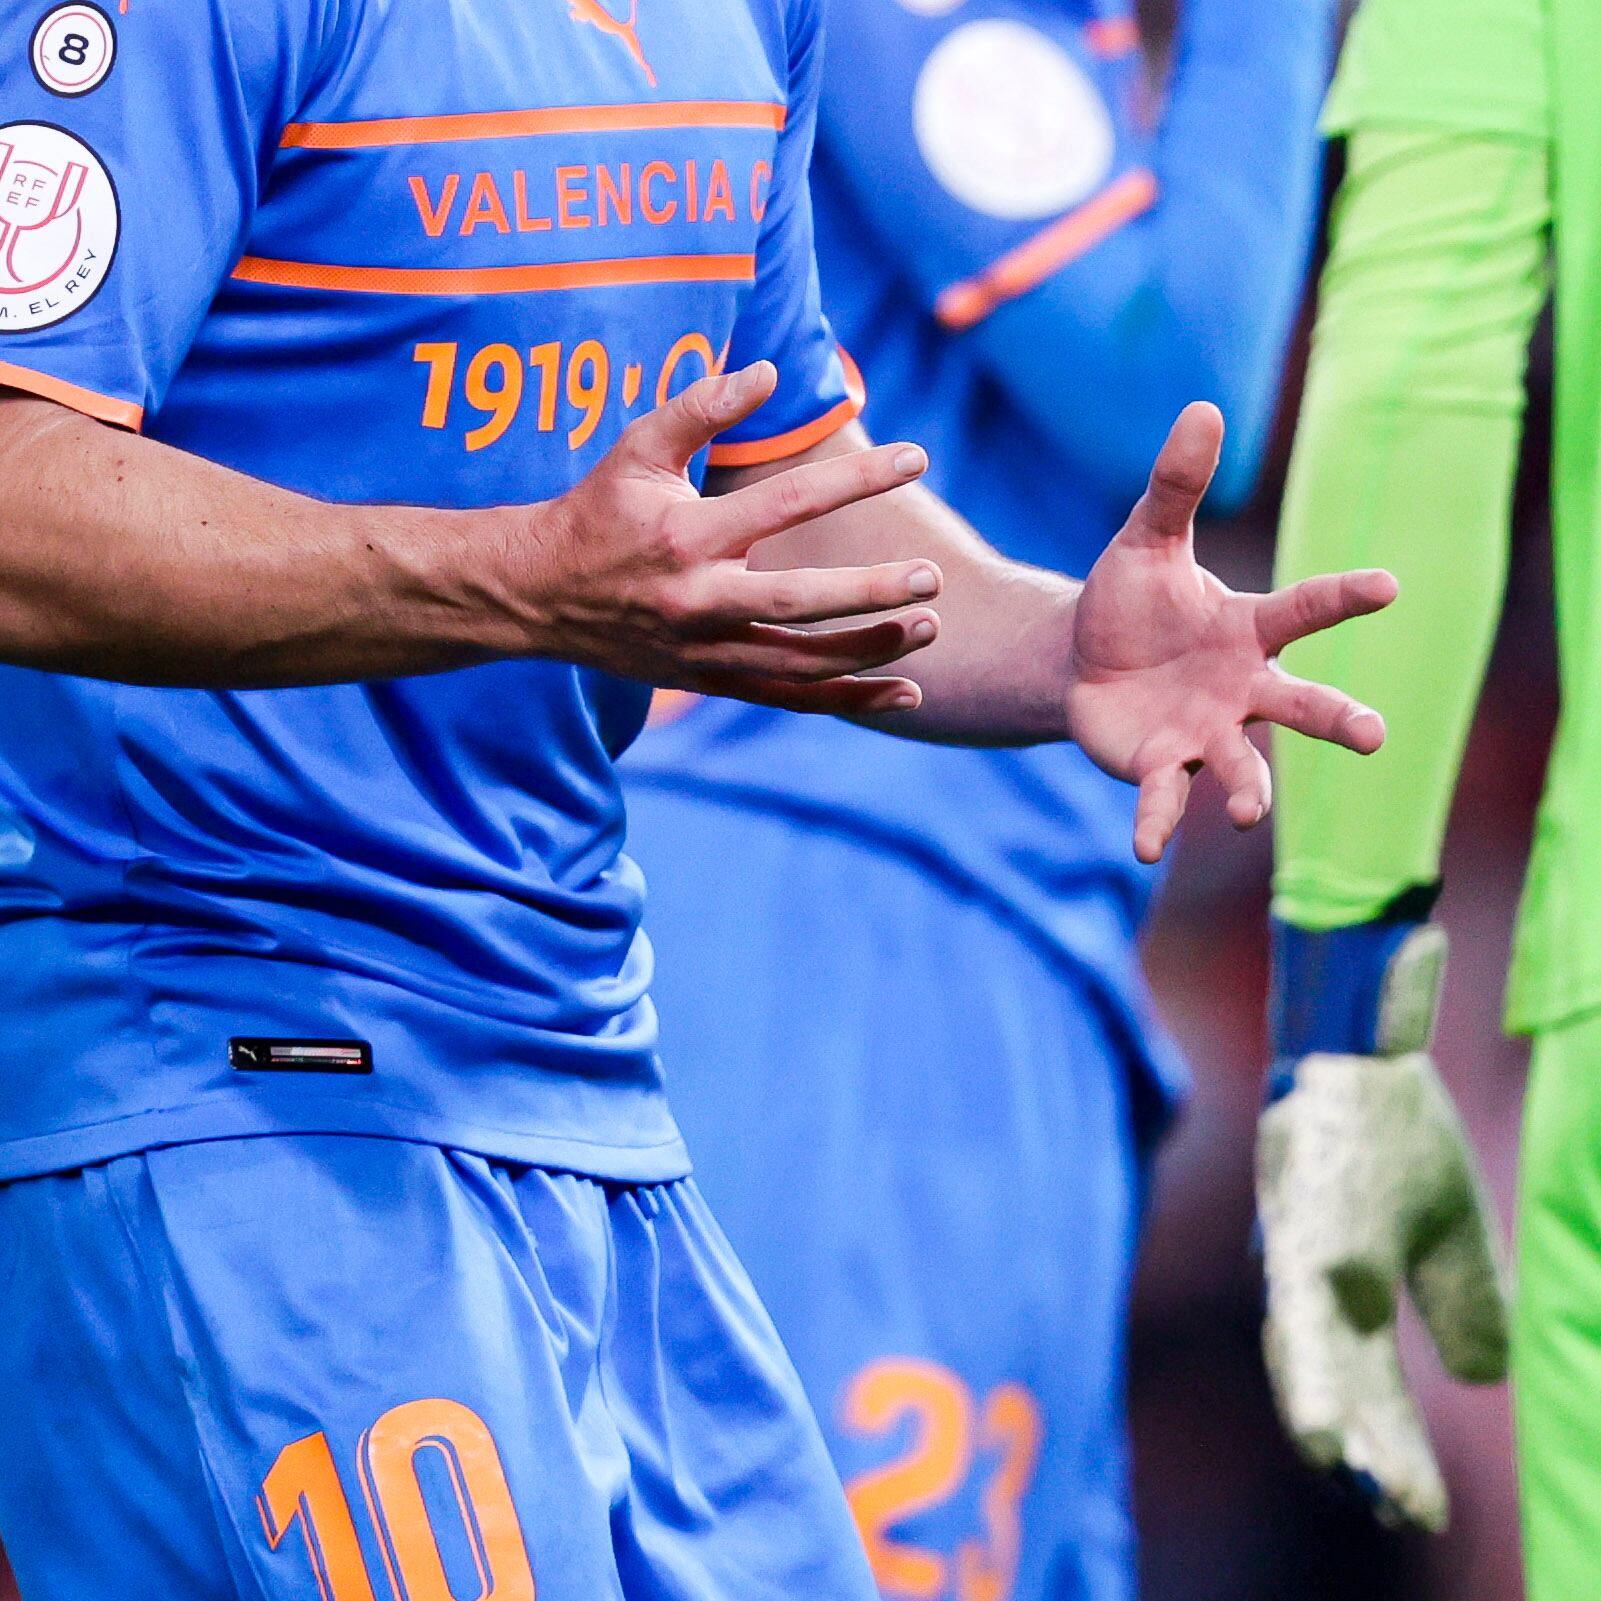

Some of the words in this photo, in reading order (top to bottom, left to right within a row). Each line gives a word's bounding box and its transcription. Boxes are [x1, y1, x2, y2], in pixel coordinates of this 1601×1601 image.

[58, 33, 90, 66] 8
[407, 159, 736, 237] VALENCIA
[29, 297, 60, 315] EL
[64, 248, 97, 293] REY
[256, 1398, 537, 1601] 10
